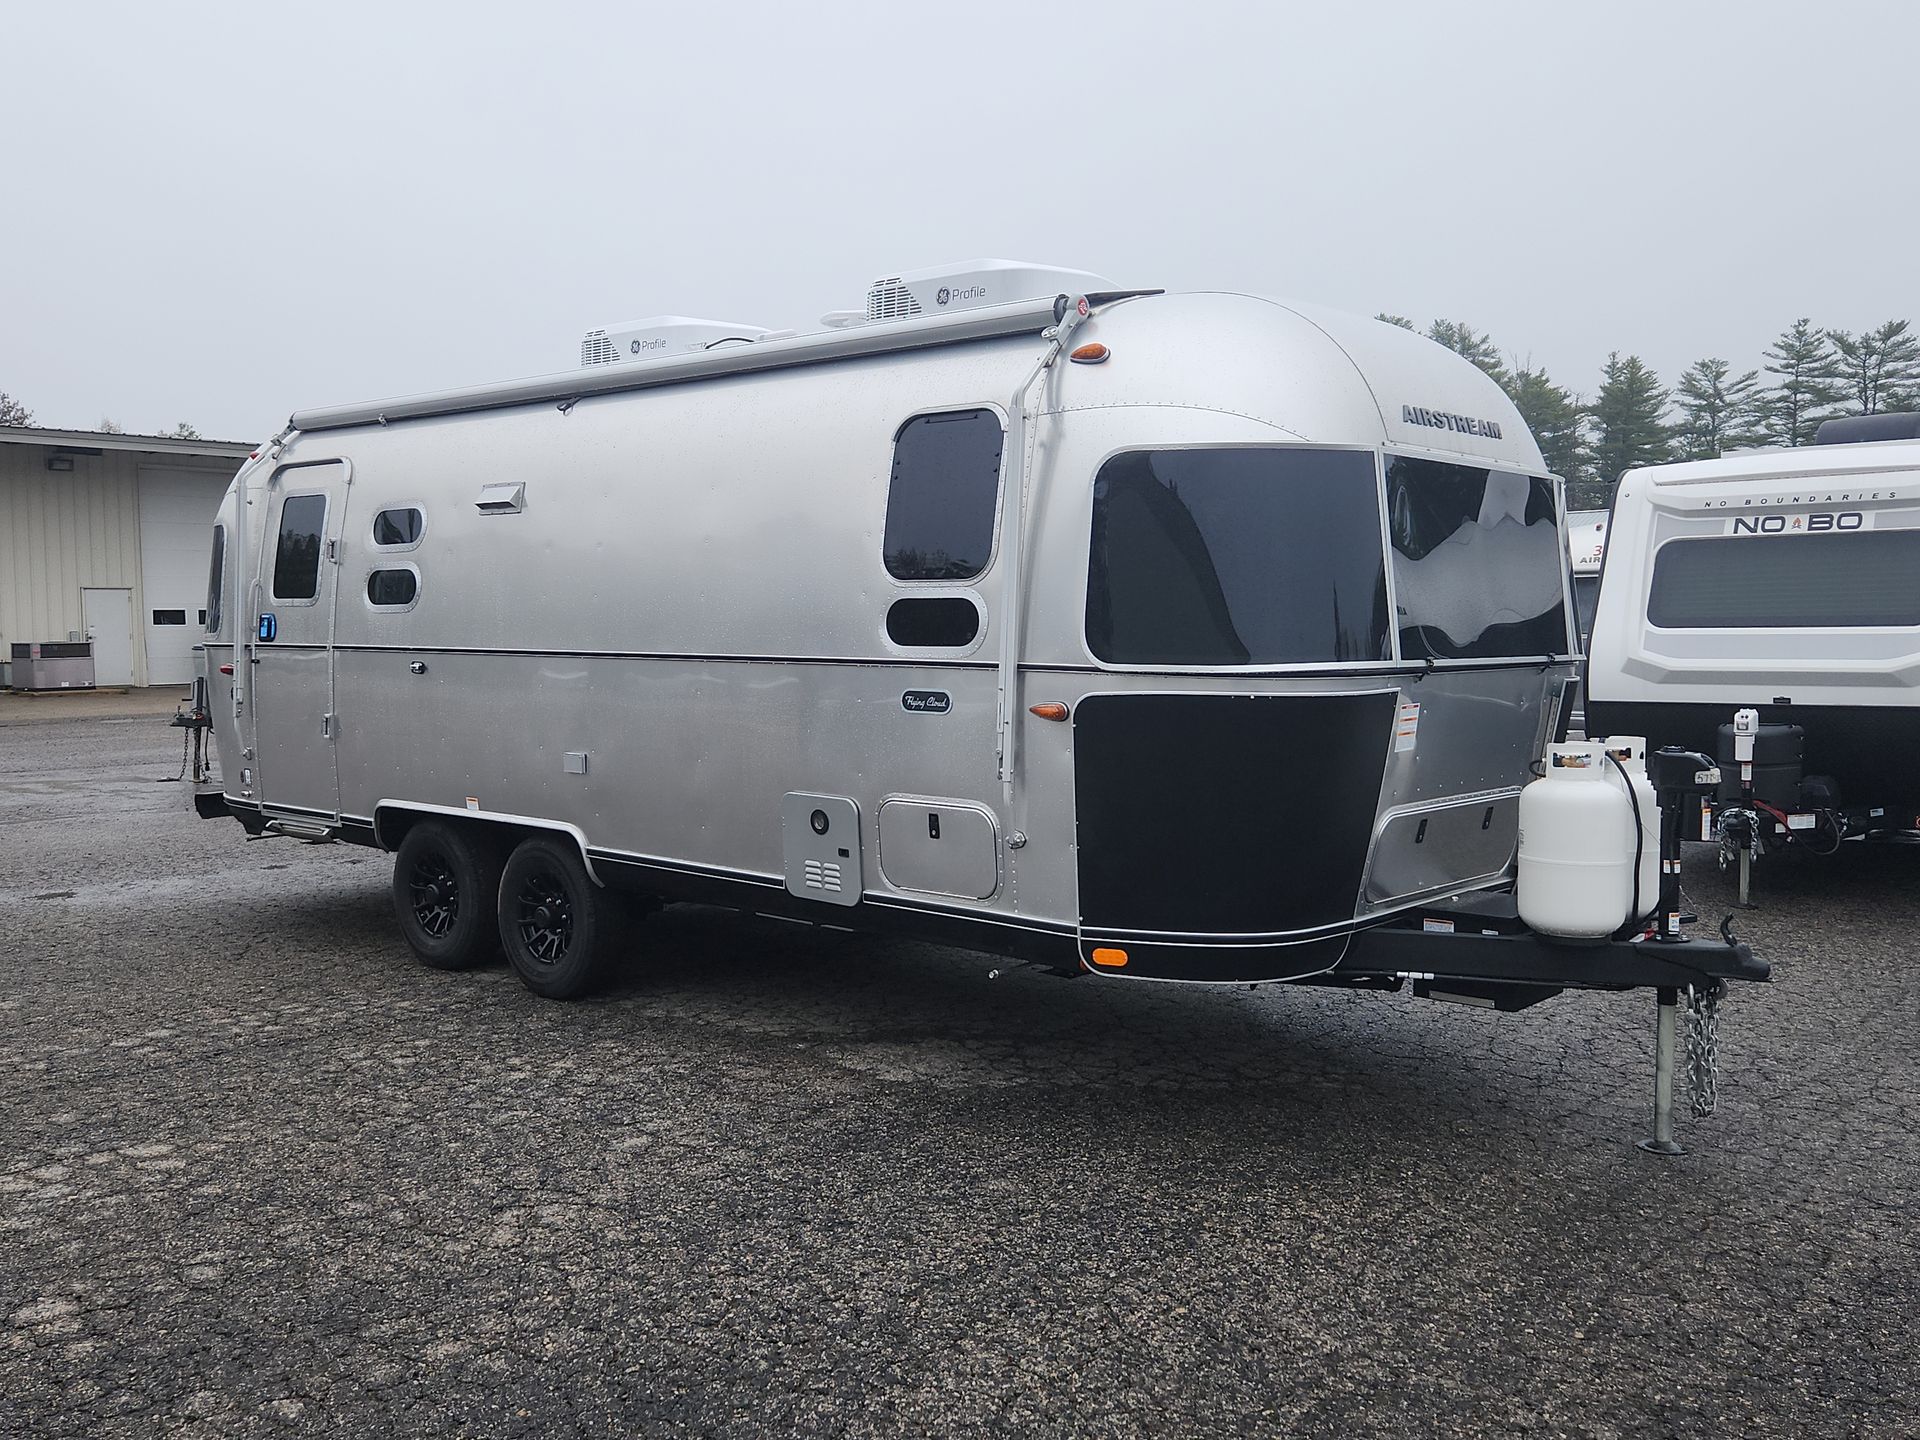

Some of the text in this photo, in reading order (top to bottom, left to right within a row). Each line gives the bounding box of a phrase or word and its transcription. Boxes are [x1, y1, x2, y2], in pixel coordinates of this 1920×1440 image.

[952, 286, 986, 301] Profile
[641, 338, 667, 351] Profile
[1402, 404, 1503, 440] AIRSTREAM
[1704, 491, 1897, 508] NO BOUNDARIES
[1733, 512, 1863, 534] NO BO
[904, 695, 947, 710] Flying Cloud
